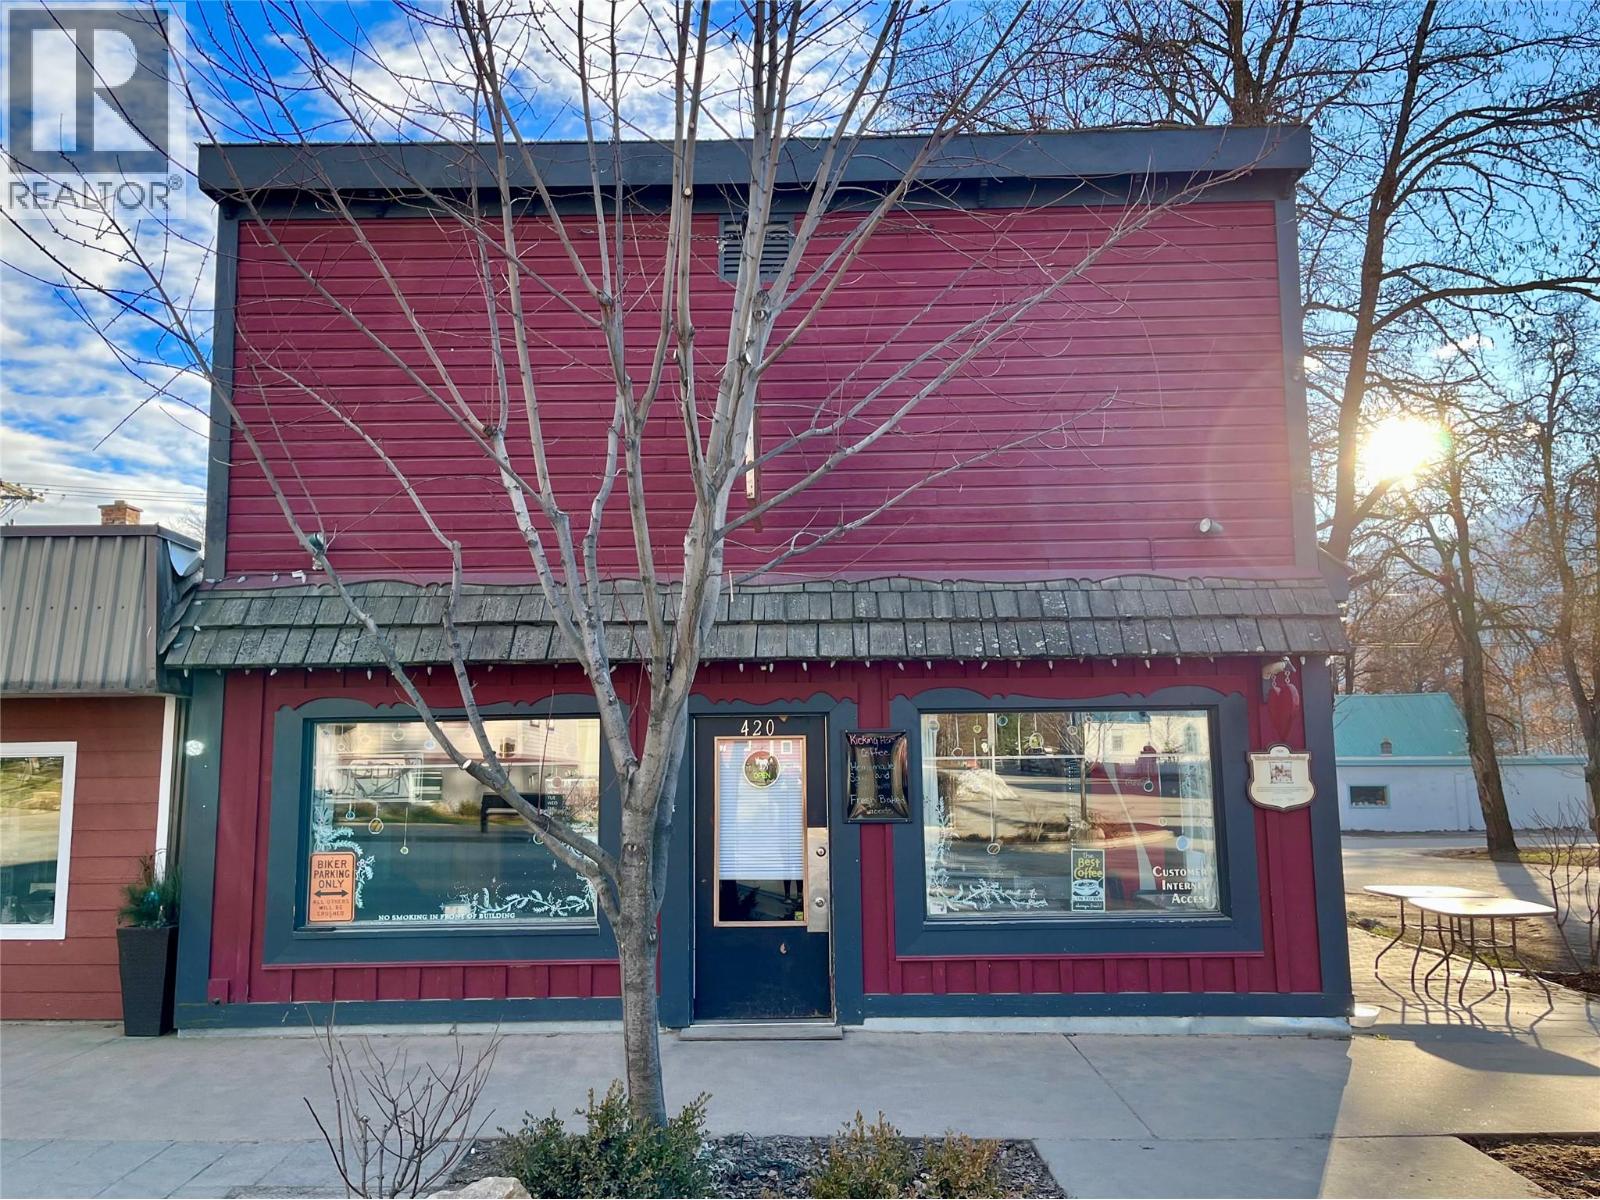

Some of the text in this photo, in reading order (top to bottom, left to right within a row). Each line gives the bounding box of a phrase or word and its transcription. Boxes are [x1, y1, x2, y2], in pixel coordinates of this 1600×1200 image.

[741, 719, 775, 736] 420
[849, 734, 879, 749] Kicking
[753, 770, 771, 779] OPEN
[317, 859, 347, 869] BIKER
[1078, 857, 1101, 868] Best
[313, 869, 350, 879] PARKING
[1073, 866, 1103, 880] Coffee
[318, 879, 344, 889] ONLY
